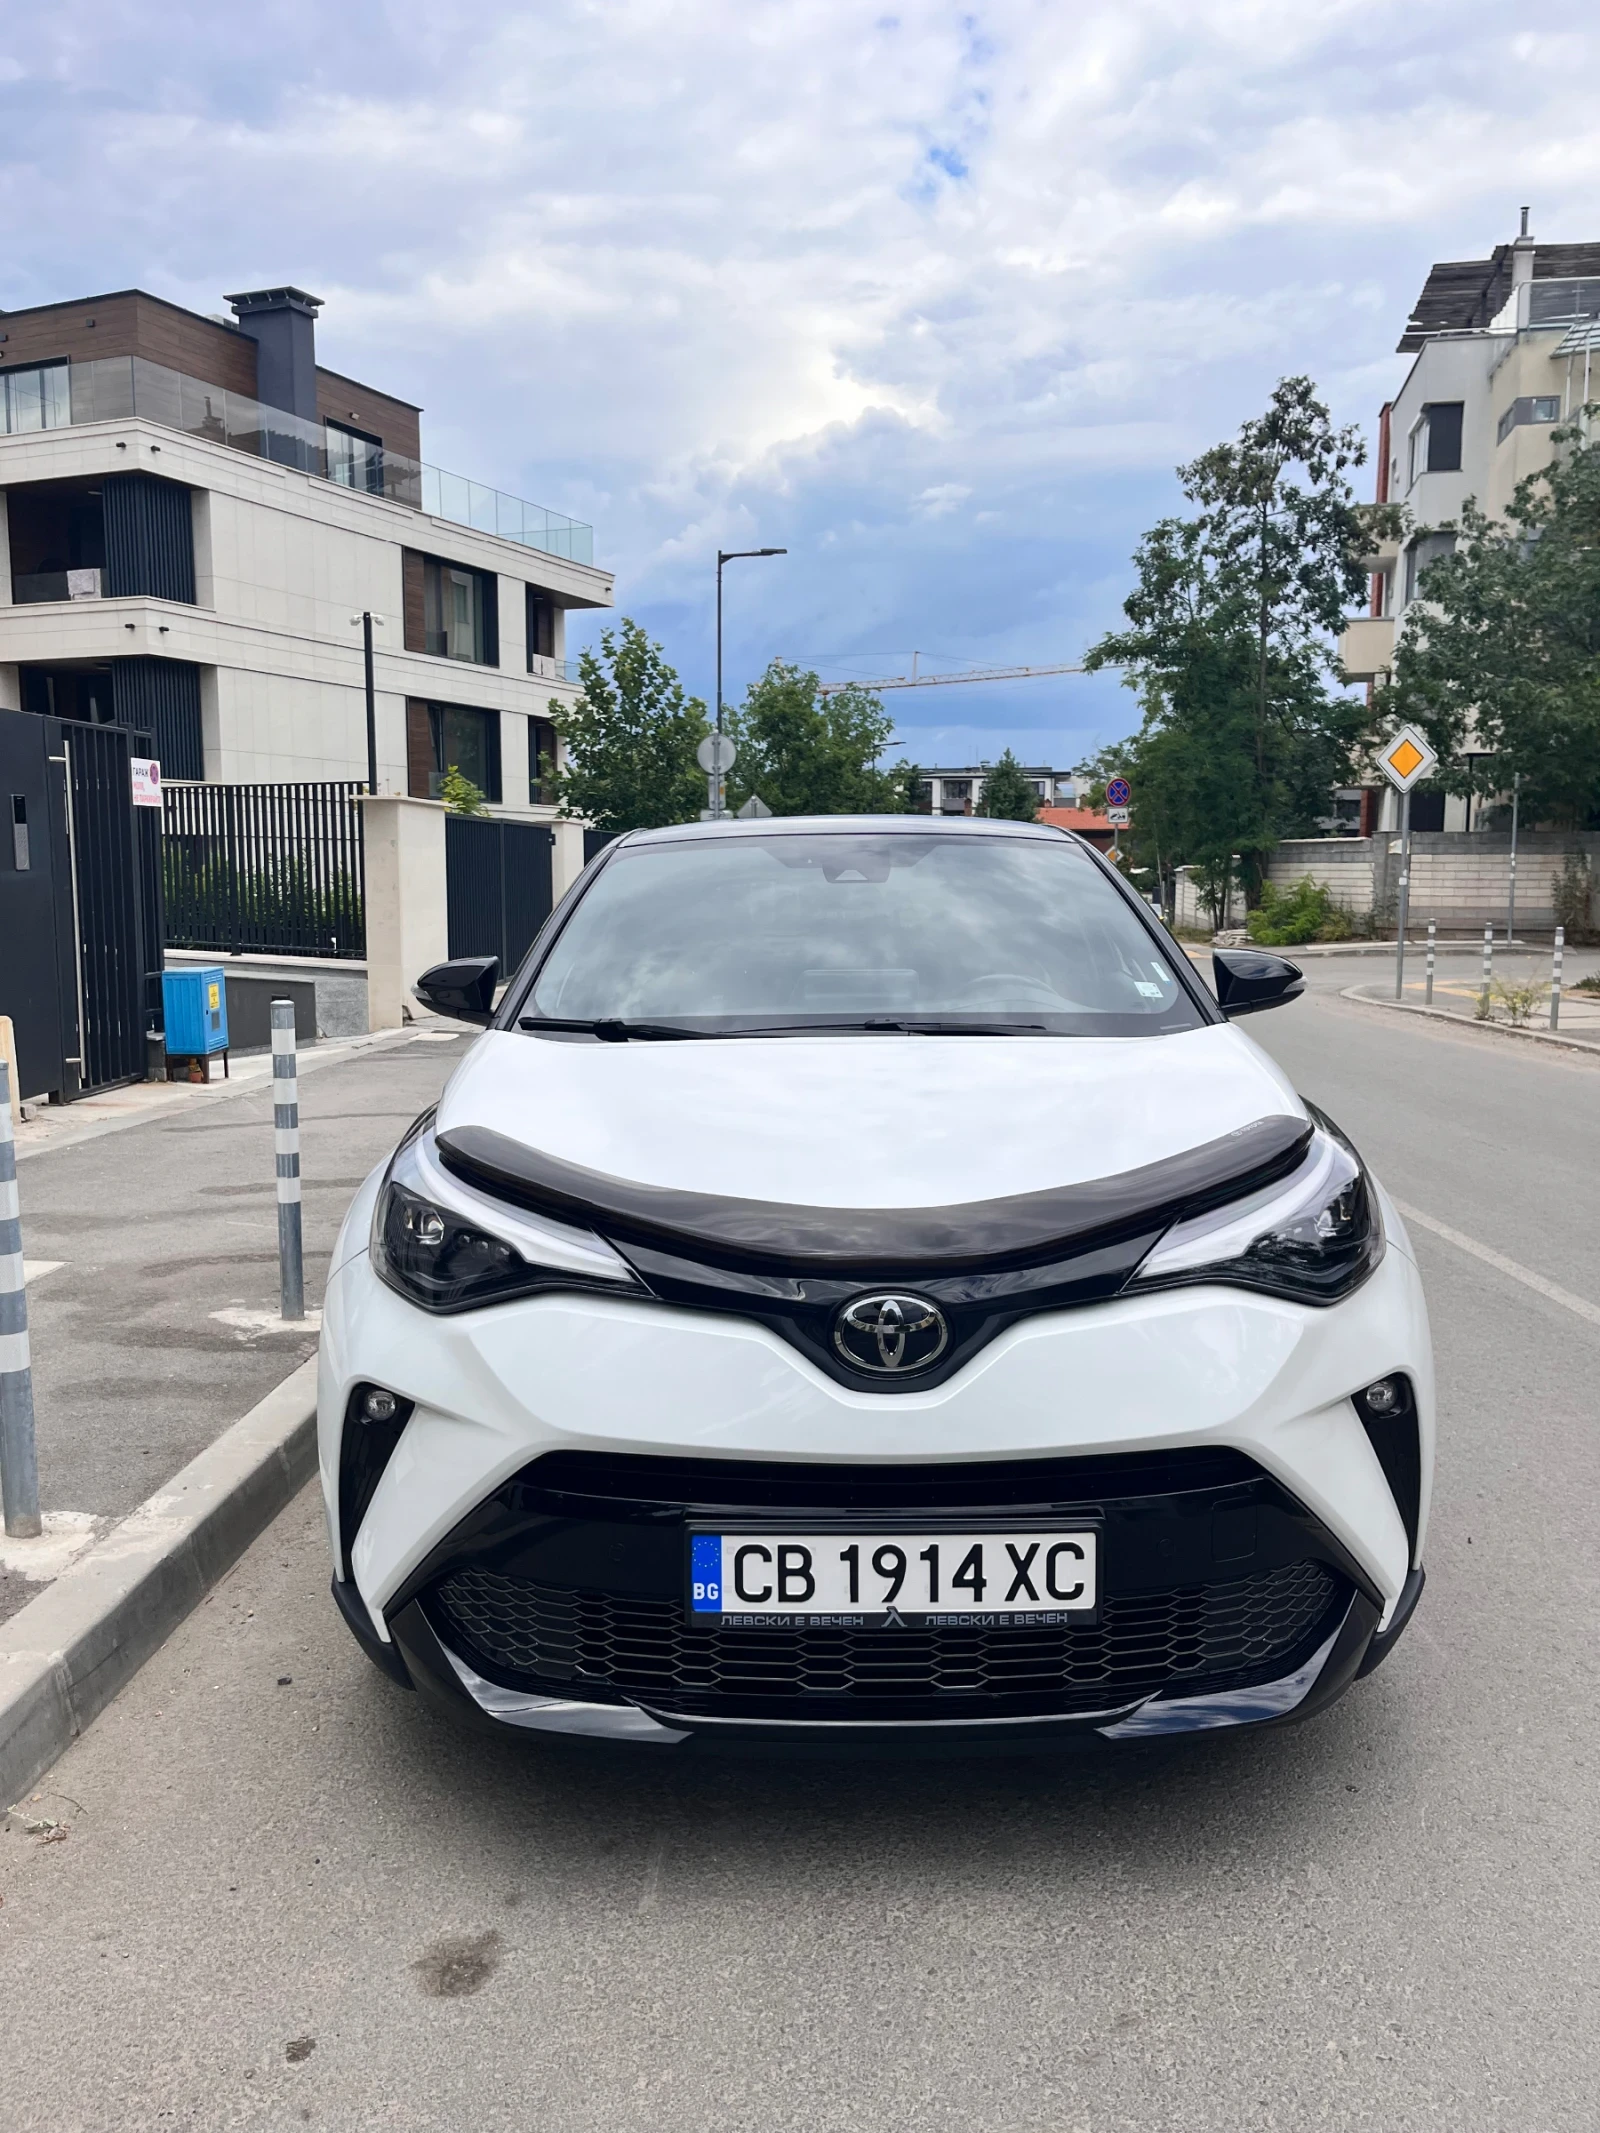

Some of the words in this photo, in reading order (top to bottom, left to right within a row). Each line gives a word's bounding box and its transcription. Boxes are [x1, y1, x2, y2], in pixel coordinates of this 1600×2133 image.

[734, 1543, 816, 1603] CB
[839, 1543, 988, 1603] 1914
[1004, 1541, 1086, 1602] XC
[693, 1582, 719, 1600] BG
[720, 1615, 791, 1626] ЛЕВСКИ
[794, 1616, 806, 1626] Е
[809, 1615, 864, 1626] ВЕЧЕН
[924, 1614, 995, 1626] ЛЕВСКИ
[999, 1614, 1010, 1625] Е
[1013, 1612, 1069, 1625] ВЕЧЕН
